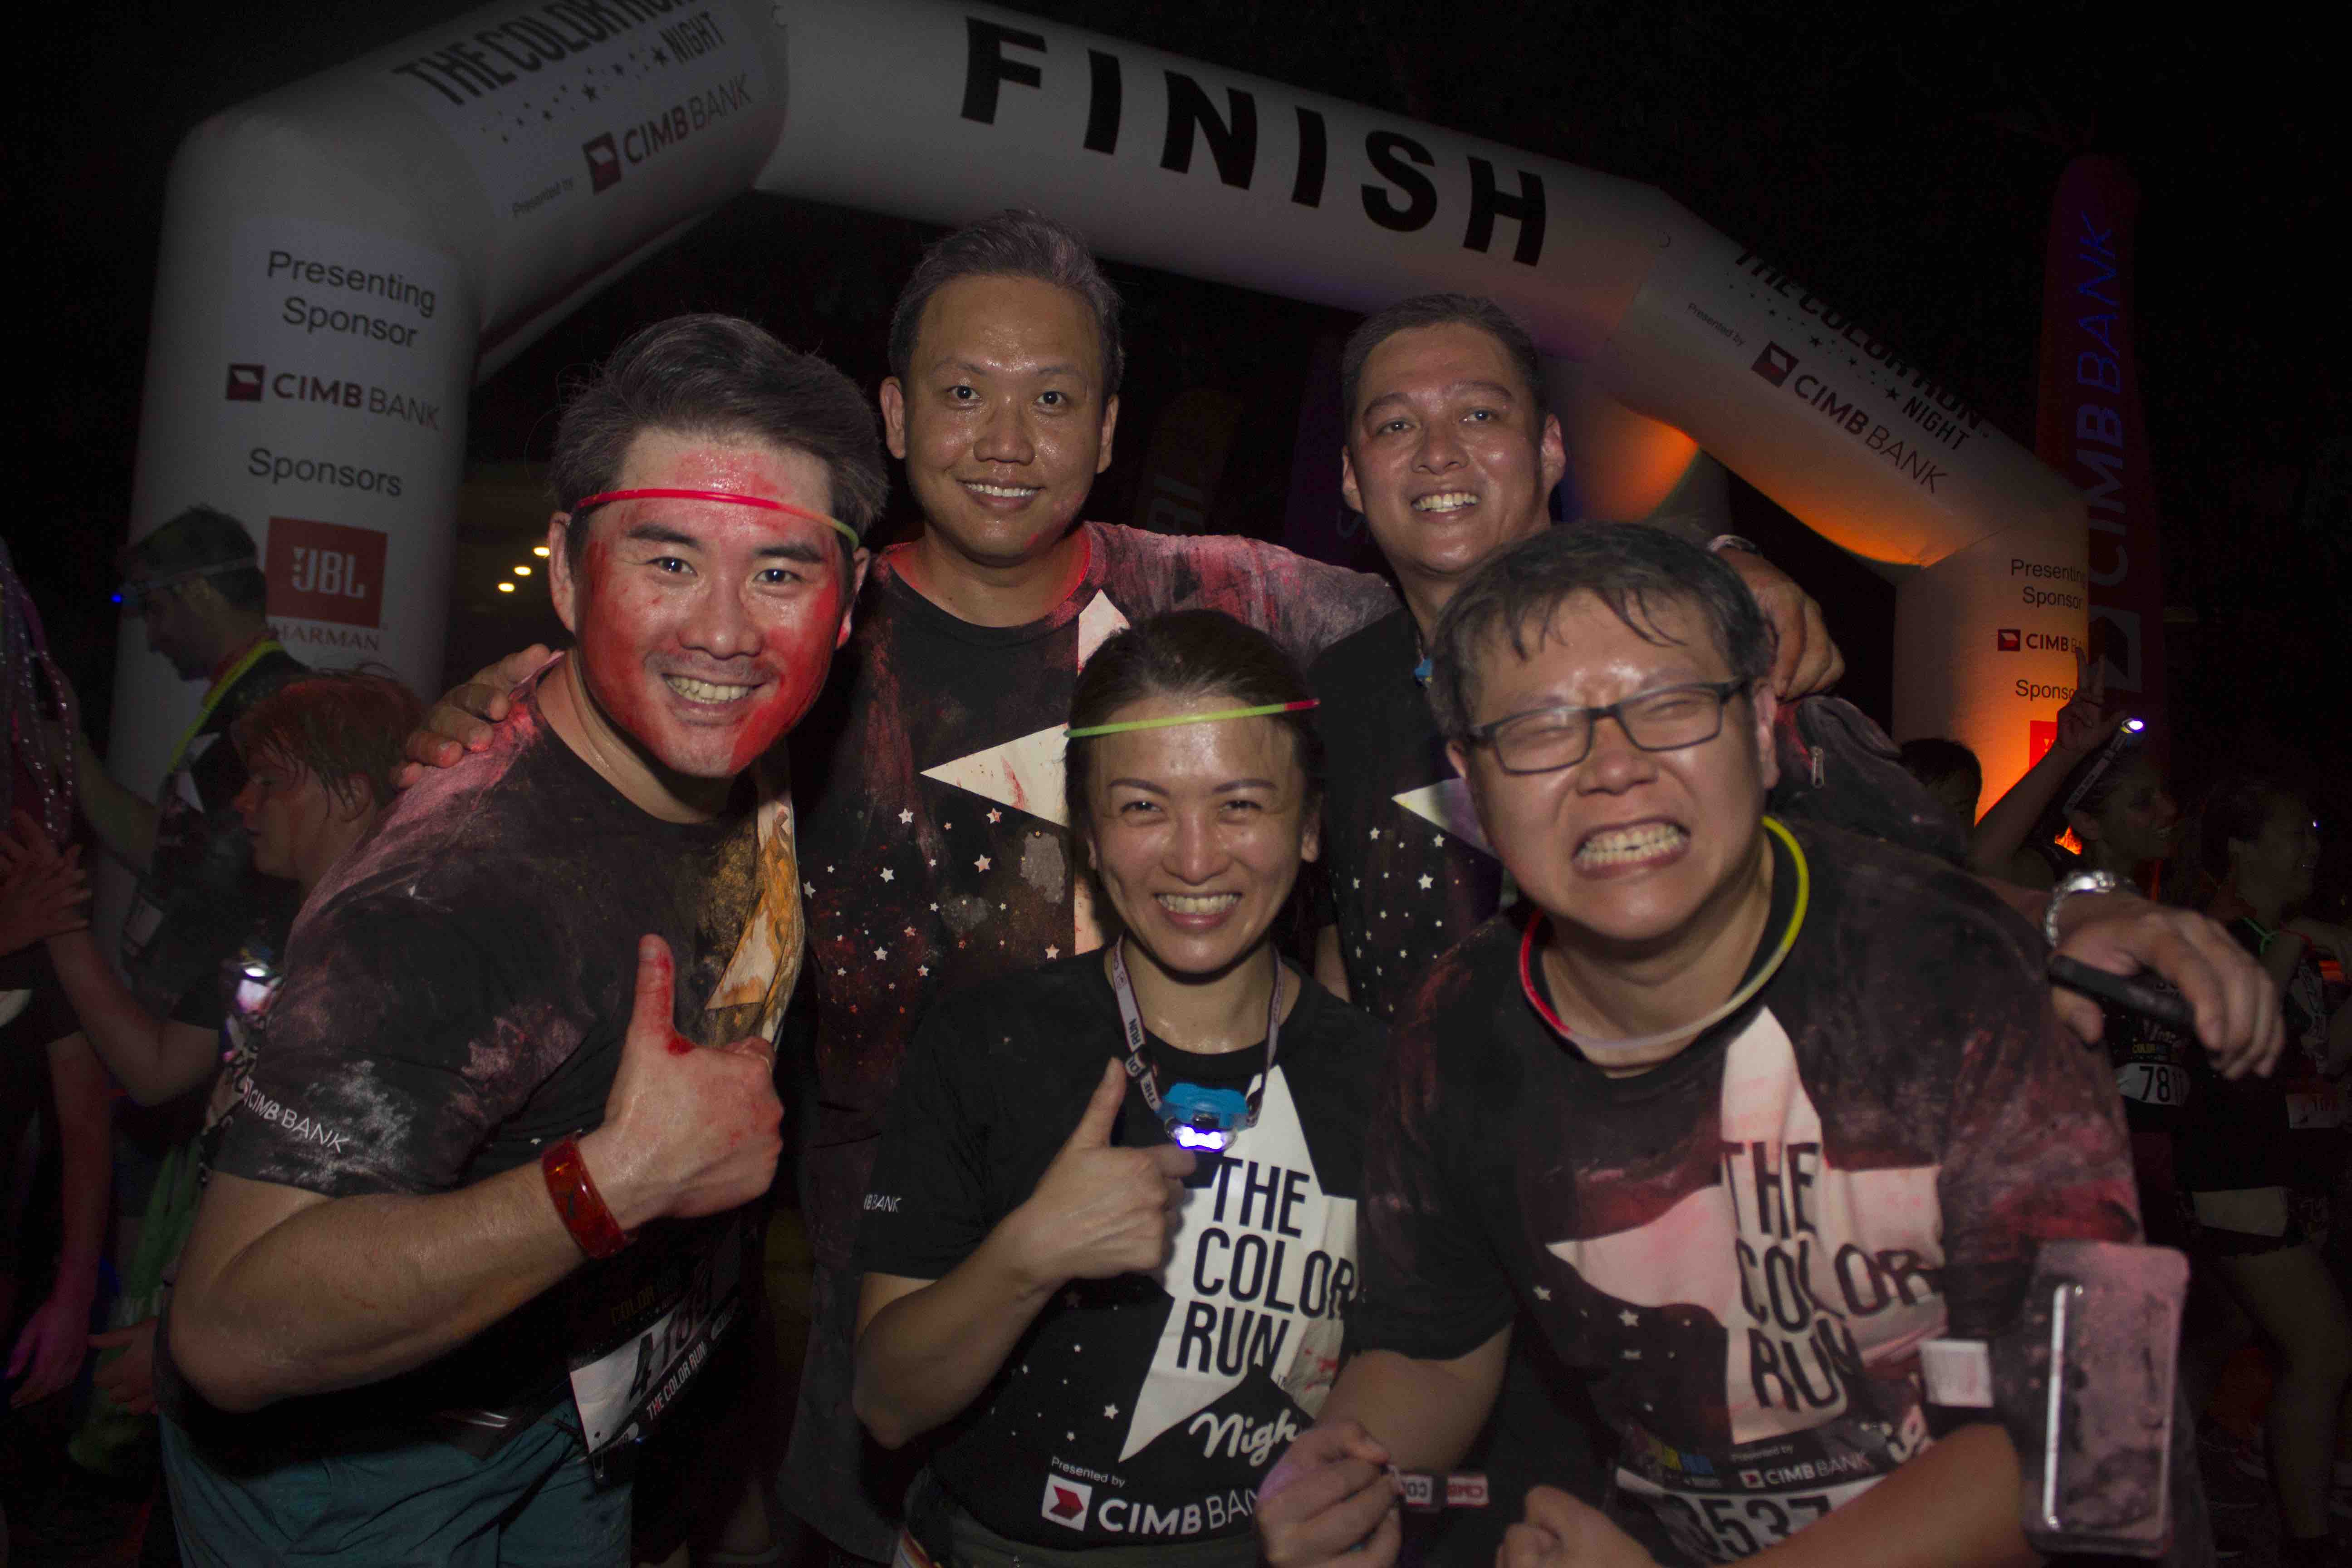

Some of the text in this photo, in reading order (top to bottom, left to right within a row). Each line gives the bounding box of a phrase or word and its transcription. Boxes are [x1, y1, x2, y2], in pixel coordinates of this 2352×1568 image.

[659, 10, 725, 64] NIGHT
[624, 74, 752, 166] CIMB BANK
[960, 16, 1546, 266] FINISH
[267, 250, 436, 318] Presenting
[283, 296, 417, 347] Sponsor
[1688, 302, 1733, 338] Presented
[273, 372, 441, 430] CIMB BANK
[1902, 396, 1969, 451] NIGHT
[2076, 210, 2129, 587] CIMB BANK
[1794, 375, 1947, 494] CIMB BANK
[249, 448, 402, 497] Sponsors
[292, 546, 366, 599] JBL
[2023, 587, 2083, 609] Sponsor
[2026, 633, 2070, 652] CIMB
[248, 1089, 349, 1153] CIMB BANK
[1213, 1156, 1309, 1238] THE
[1725, 1142, 1820, 1240] THE
[1193, 1228, 1355, 1320] COLOR
[1736, 1239, 1921, 1334] COLOR
[1176, 1301, 1290, 1376] RUN
[1748, 1318, 1863, 1412] RUN
[647, 1340, 708, 1421] THE COLOR RUN
[1189, 1407, 1298, 1467] Nigh
[1765, 1451, 1870, 1485] CIMB BANK
[1051, 1455, 1125, 1488] Presented by
[1098, 1488, 1258, 1535] CIMB BAN
